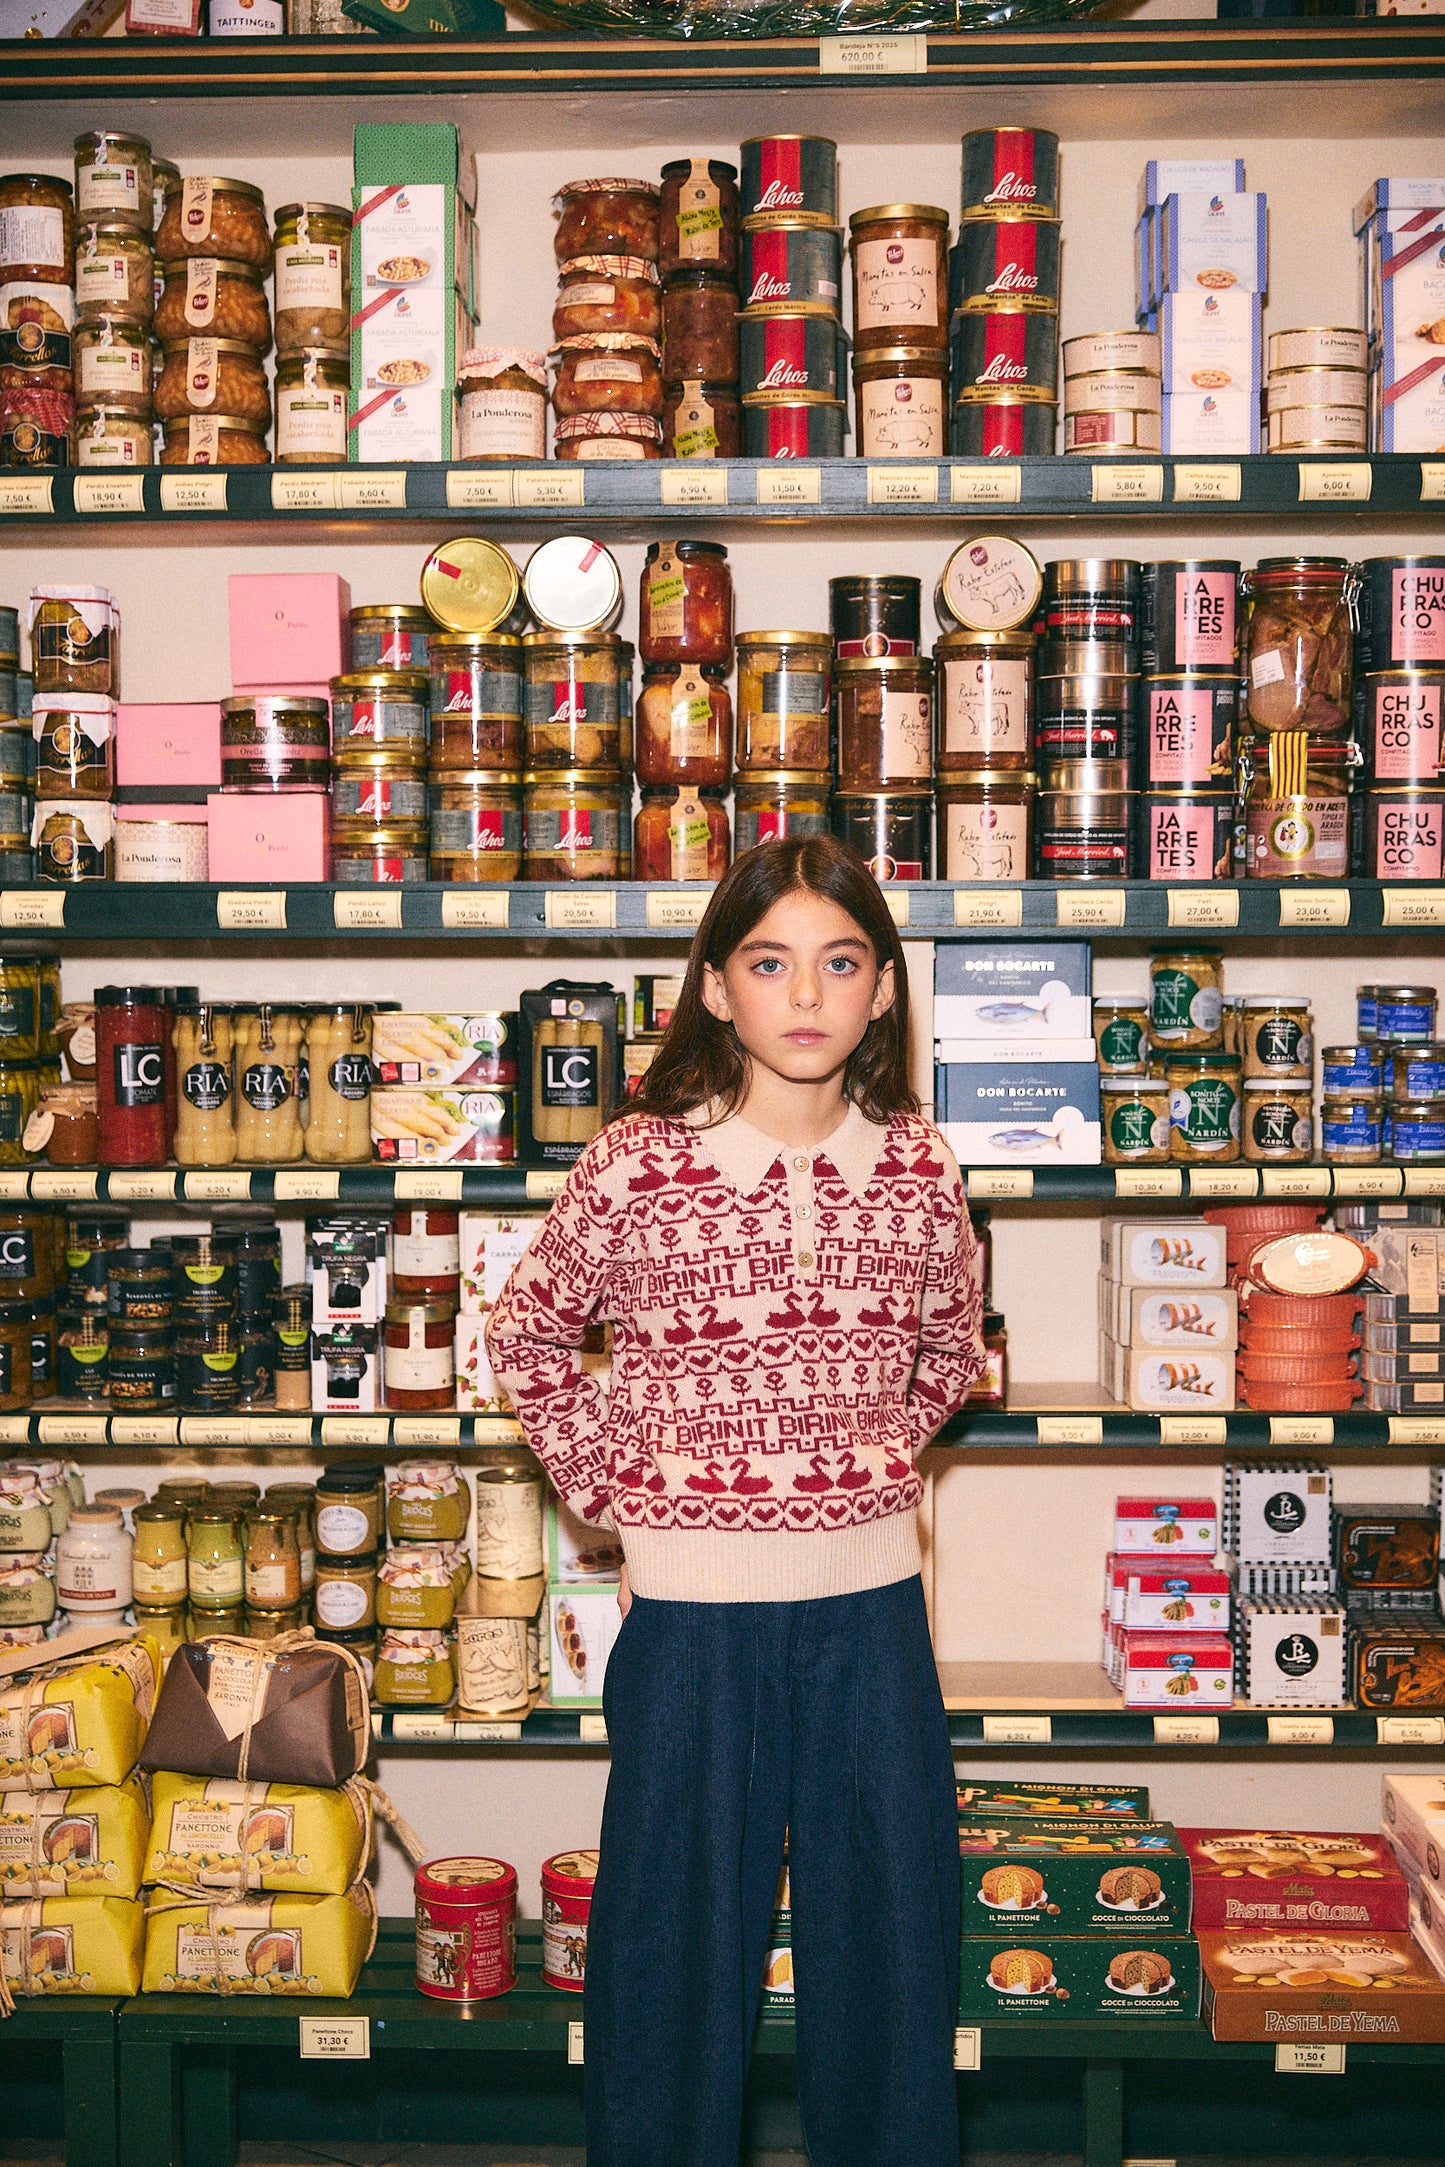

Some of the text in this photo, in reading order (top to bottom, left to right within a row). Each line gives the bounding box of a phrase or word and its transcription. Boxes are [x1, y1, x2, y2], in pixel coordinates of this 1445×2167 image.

[217, 18, 276, 29] TAITTINGER
[841, 52, 884, 63] 620,00 €
[983, 172, 1037, 203] Lahoz
[753, 180, 804, 212] Lahoz
[985, 263, 1038, 293] Lahoz
[747, 272, 791, 304] Lahoz
[757, 359, 809, 389] Lahoz
[975, 353, 1028, 384] Lahoz
[472, 408, 533, 419] La Ponderosa
[466, 487, 493, 496] 7,50 €
[537, 486, 563, 495] 5,30 €
[681, 485, 708, 494] 6,90 €
[772, 485, 795, 493] 11,50
[886, 484, 918, 493] 12,20 €
[972, 483, 999, 492] 7,20 €
[1116, 482, 1143, 491] 5,80 €
[1194, 483, 1221, 492] 9,50 €
[1324, 482, 1351, 491] 6,00 €
[92, 492, 122, 501] 18,90 €
[175, 490, 206, 499] 12,50 €
[286, 489, 317, 499] 17,80 €
[359, 489, 385, 498] 6,60 €
[1400, 577, 1445, 594] CHU
[1400, 613, 1432, 629] CO
[376, 645, 412, 666] Lahoz
[443, 690, 479, 712] Laho
[1156, 696, 1179, 713] JA
[1382, 695, 1426, 711] CHU
[548, 700, 588, 723] Lahoz
[1382, 713, 1434, 730] RRAS
[1156, 734, 1194, 752] TES
[1381, 732, 1411, 748] CO
[355, 793, 392, 814] Lahoz
[1157, 812, 1180, 829] JA
[1384, 813, 1429, 829] CHU
[467, 827, 506, 850] Lahoz
[553, 827, 593, 850] Lahoz
[1157, 830, 1198, 848] RRE
[1384, 830, 1437, 847] RRAS
[121, 854, 130, 863] La
[1157, 850, 1196, 867] TES
[1384, 848, 1415, 865] CO
[232, 910, 263, 919] 29,50 €
[349, 911, 381, 920] 17,80 €
[456, 911, 487, 919] 19,50 €
[564, 909, 594, 918] 20,50 €
[662, 909, 693, 918] 10,90 €
[969, 909, 1002, 918] 21,90 €
[1072, 909, 1096, 917] 25,90
[1187, 907, 1220, 916] 27,00 €
[1296, 907, 1328, 916] 23,00 €
[1402, 906, 1435, 915] 25,00 €
[14, 912, 44, 921] 12,50 €
[965, 961, 1056, 973] DON BOCARTE
[466, 1024, 502, 1040] RIA
[120, 1053, 162, 1088] LC
[333, 1063, 373, 1084] RIA
[547, 1055, 592, 1089] LC
[186, 1072, 228, 1093] RIA
[245, 1071, 287, 1093] RIA
[976, 1087, 1067, 1098] DON BOCARTE
[465, 1100, 497, 1115] RIA
[1188, 1127, 1229, 1138] NARDÍN
[648, 1263, 738, 1292] BIRINIT
[856, 1254, 926, 1278] BIRINI
[676, 1416, 769, 1445] BIRINIT
[1020, 1784, 1076, 1793] MIGNON
[1097, 1786, 1139, 1796] GALUP
[187, 1813, 224, 1822] CHIOSTRO
[175, 1823, 233, 1833] PANETTONE
[1200, 1839, 1375, 1852] PASTEL DE GLORIA
[1226, 1899, 1370, 1922] PASTEL DE GLORIA
[989, 1914, 1041, 1922] IL PANETTONE
[1091, 1914, 1116, 1923] GOCCE
[1124, 1914, 1170, 1923] CIOCCOLATO
[1228, 1945, 1394, 1956] PASTEL DE YEMA
[770, 1996, 795, 2004] PARAD
[998, 1998, 1050, 2007] IL PANETTONE
[1101, 1999, 1125, 2008] GOCCE
[1134, 1999, 1180, 2008] CIOCCOLATO
[1265, 2011, 1400, 2033] PASTEL DE YEMA
[312, 2028, 336, 2036] Panettone
[317, 2037, 349, 2046] 31,30 €
[1294, 2052, 1326, 2062] 11,50 €
